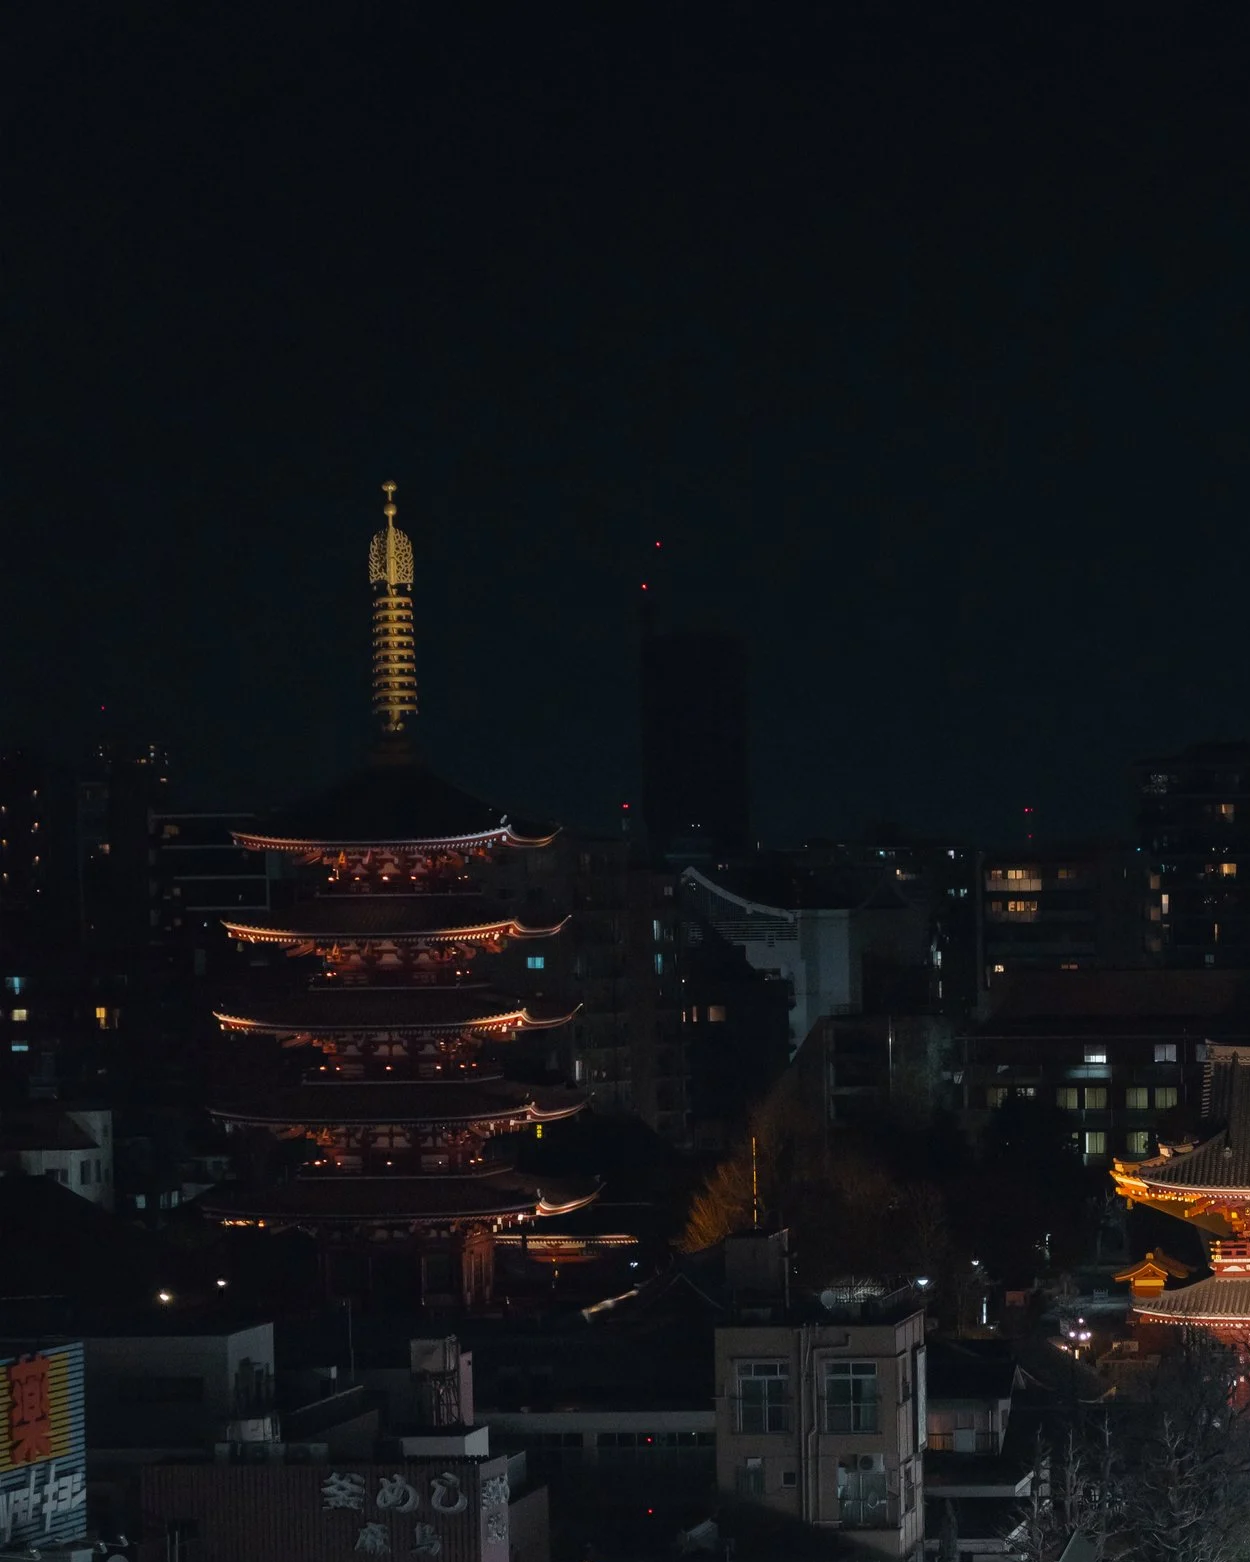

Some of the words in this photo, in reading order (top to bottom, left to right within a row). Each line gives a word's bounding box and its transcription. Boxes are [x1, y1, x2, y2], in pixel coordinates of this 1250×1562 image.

[7, 1351, 51, 1464] 薬
[320, 1471, 468, 1514] 釜めし
